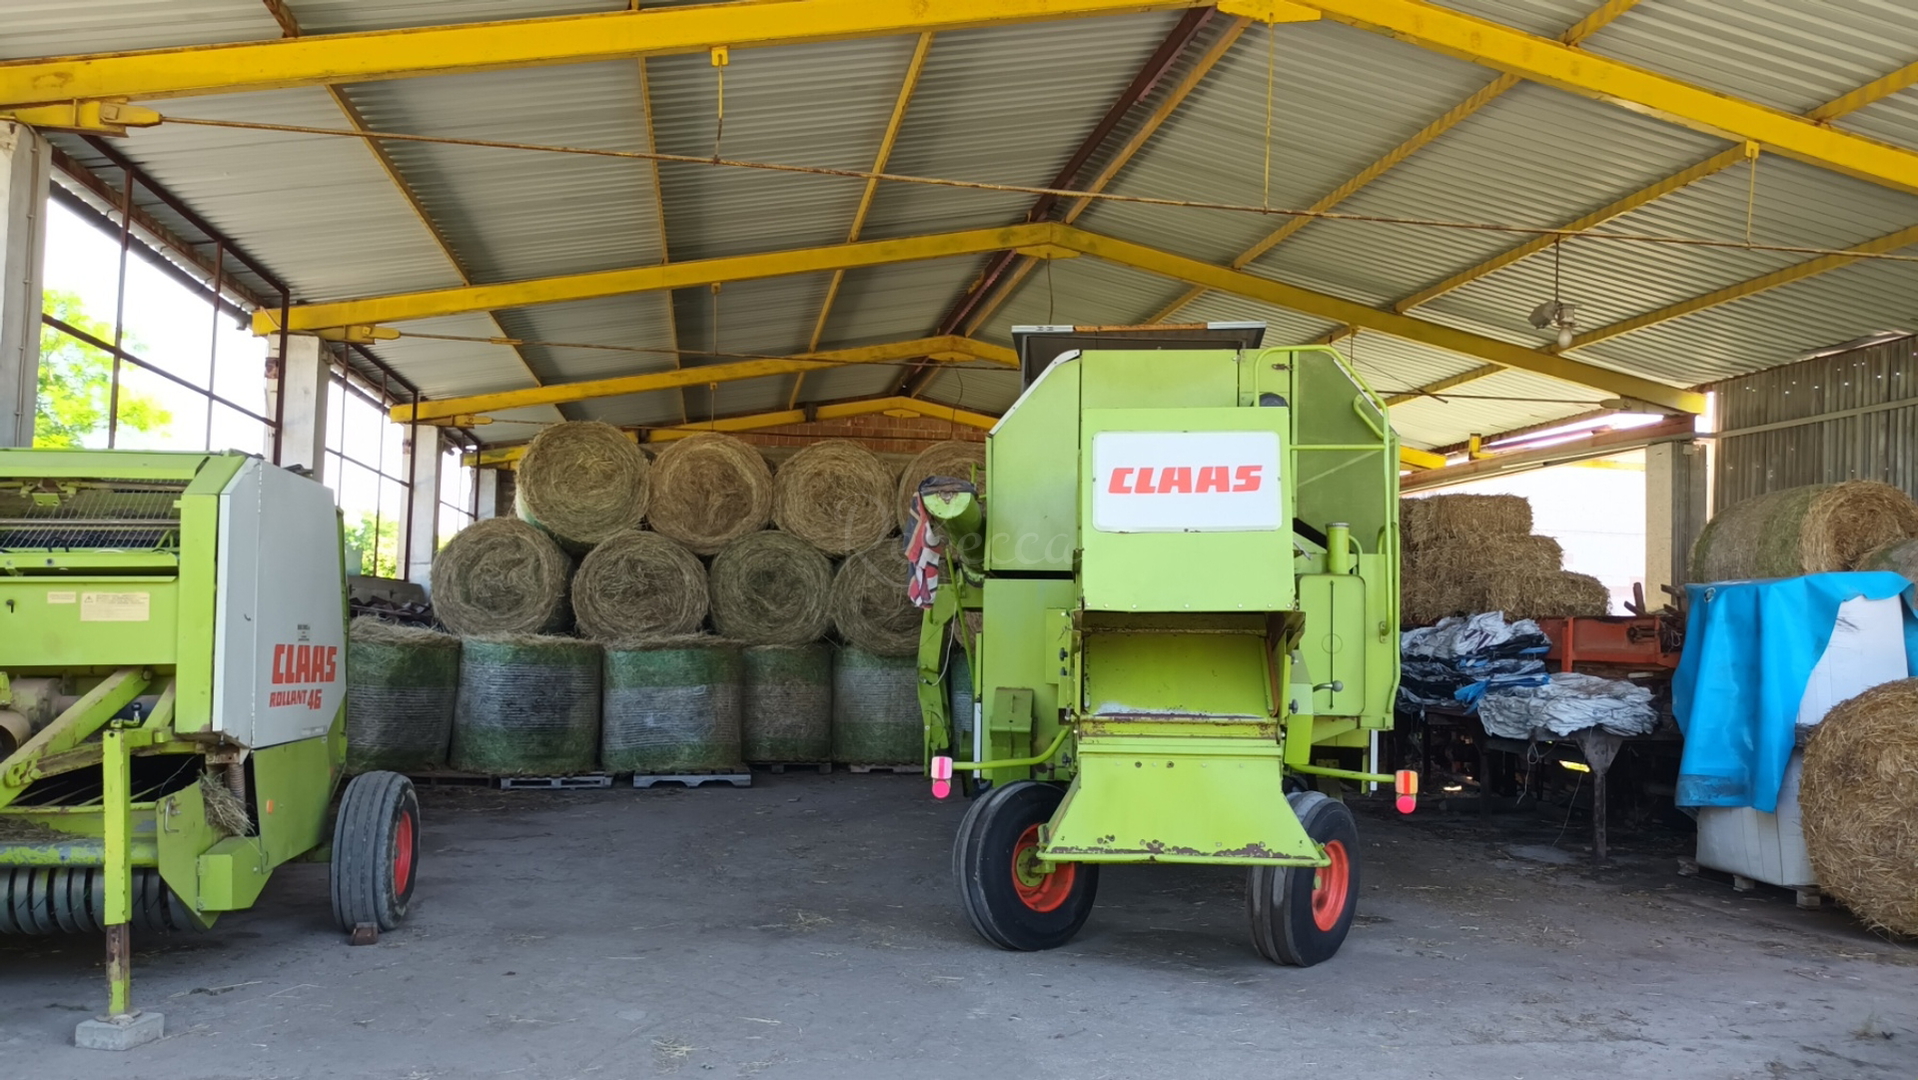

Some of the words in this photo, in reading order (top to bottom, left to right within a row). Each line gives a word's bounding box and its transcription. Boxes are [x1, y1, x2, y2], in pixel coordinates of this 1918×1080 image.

[1109, 465, 1263, 494] CLAAS
[272, 644, 337, 684] CLAAS
[269, 690, 307, 708] ROLLANT
[307, 688, 322, 710] 46
